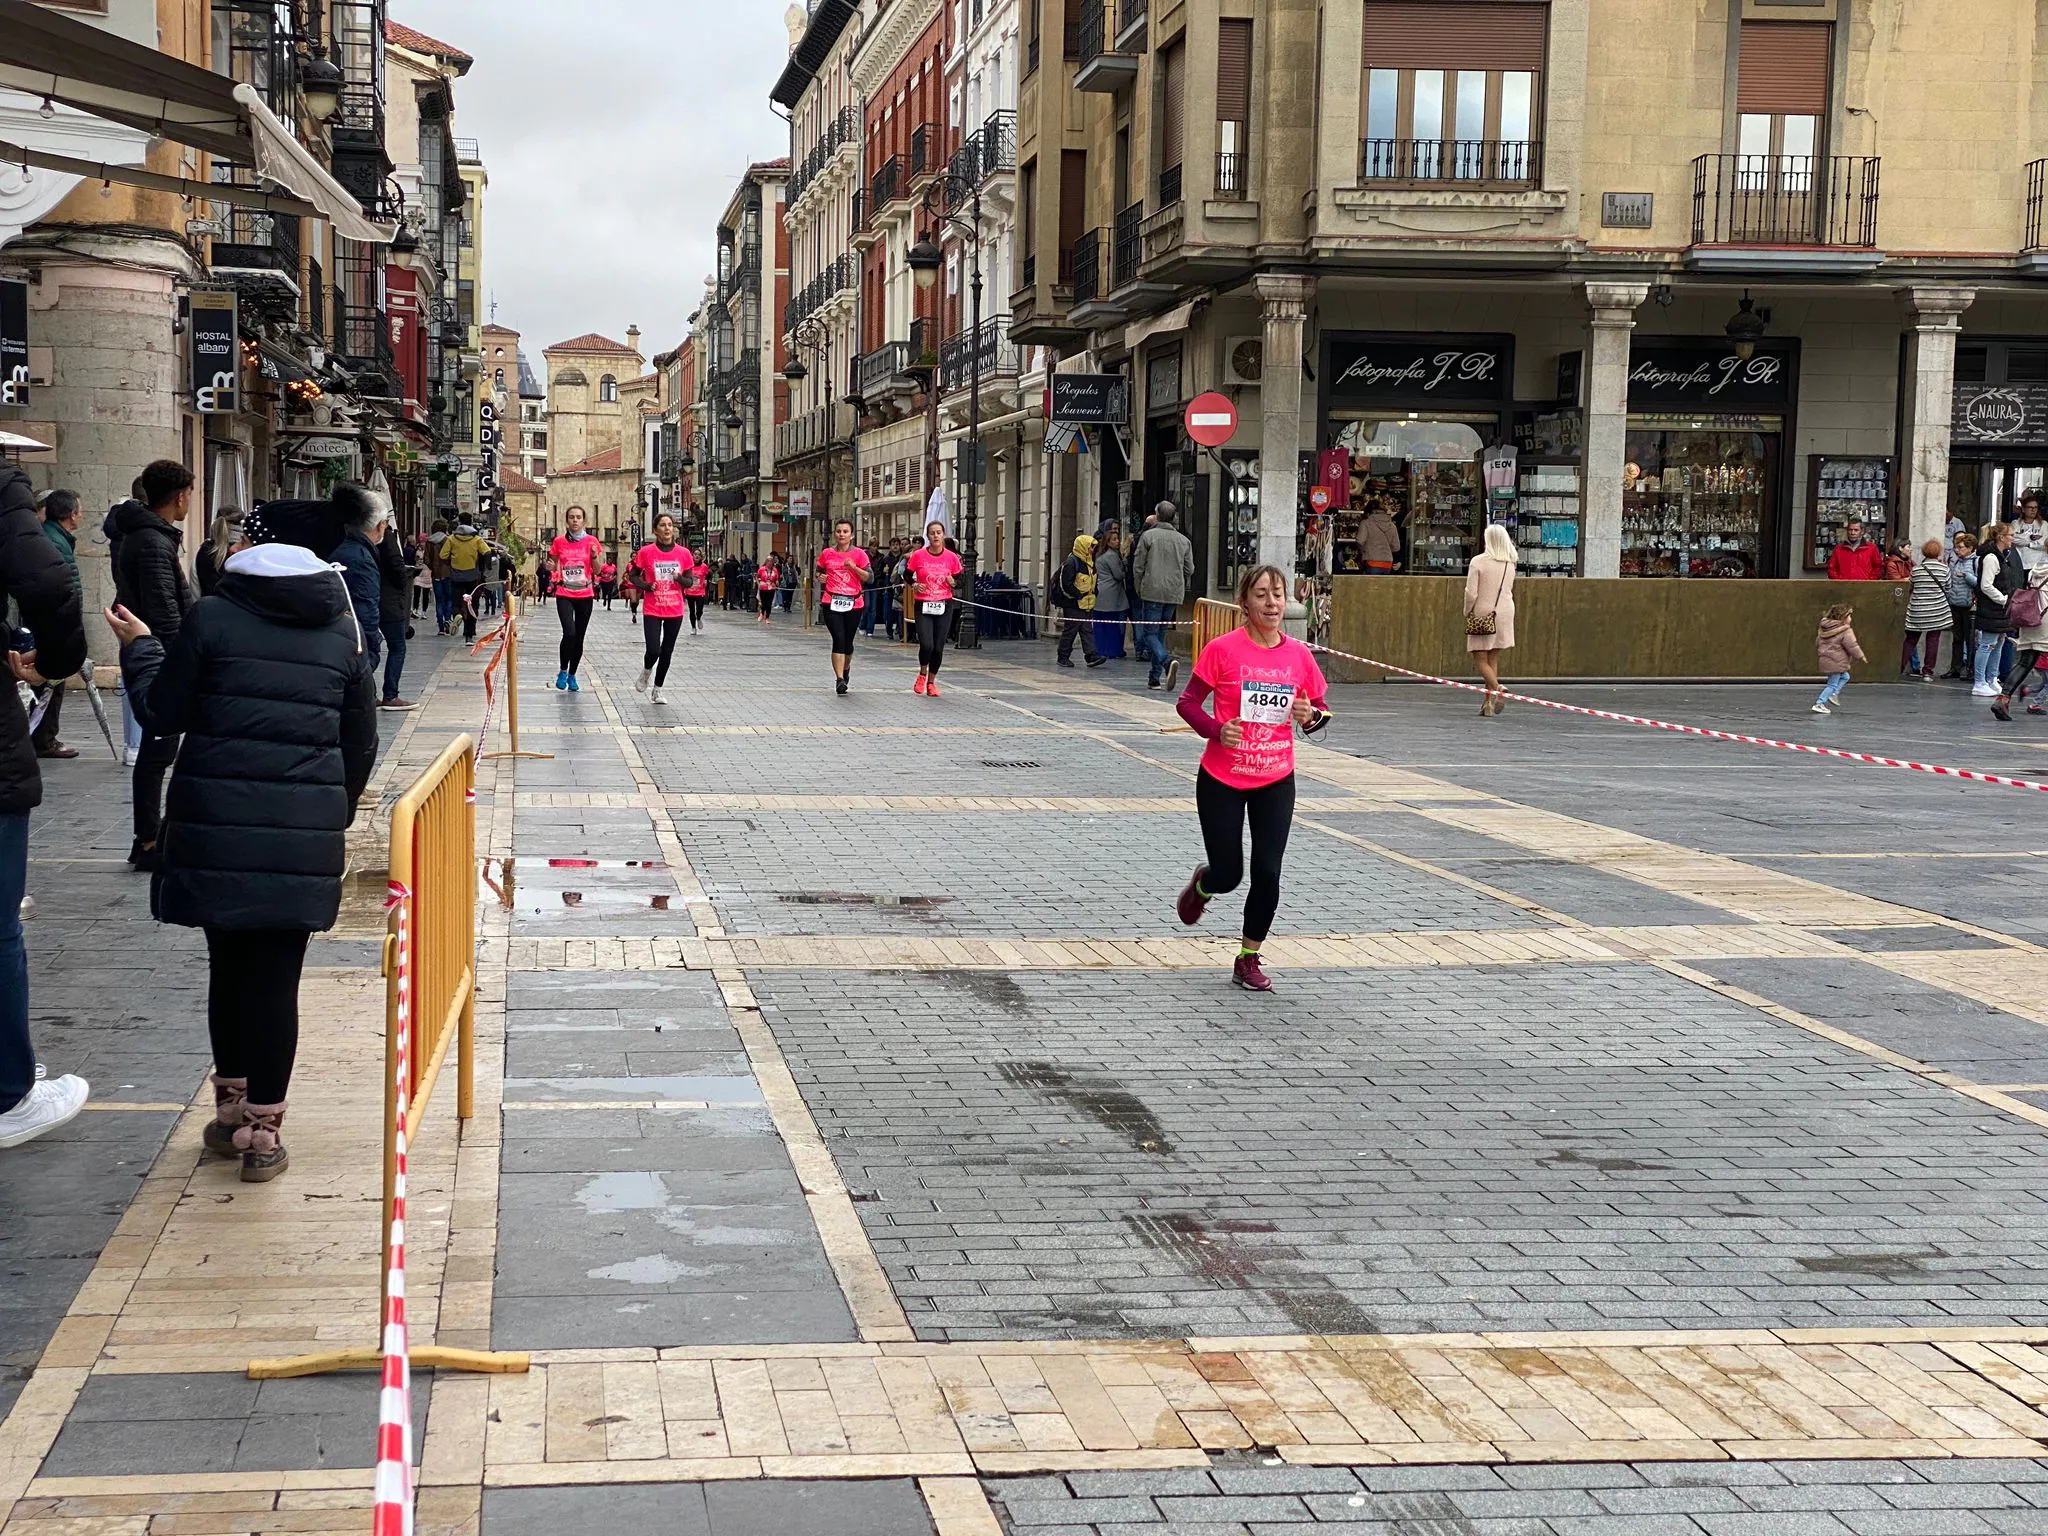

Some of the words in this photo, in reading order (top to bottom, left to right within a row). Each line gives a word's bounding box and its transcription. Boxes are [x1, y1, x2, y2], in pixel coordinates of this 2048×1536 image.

[195, 332, 231, 341] HOSTAL
[197, 343, 230, 353] albany
[1335, 356, 1426, 386] fotografia
[1628, 360, 1711, 391] fotografia
[1055, 381, 1099, 400] Regalos
[1056, 401, 1103, 415] Souvenir
[1978, 403, 2013, 420] NAURA
[300, 442, 348, 453] inoteca
[1248, 692, 1289, 708] 4840
